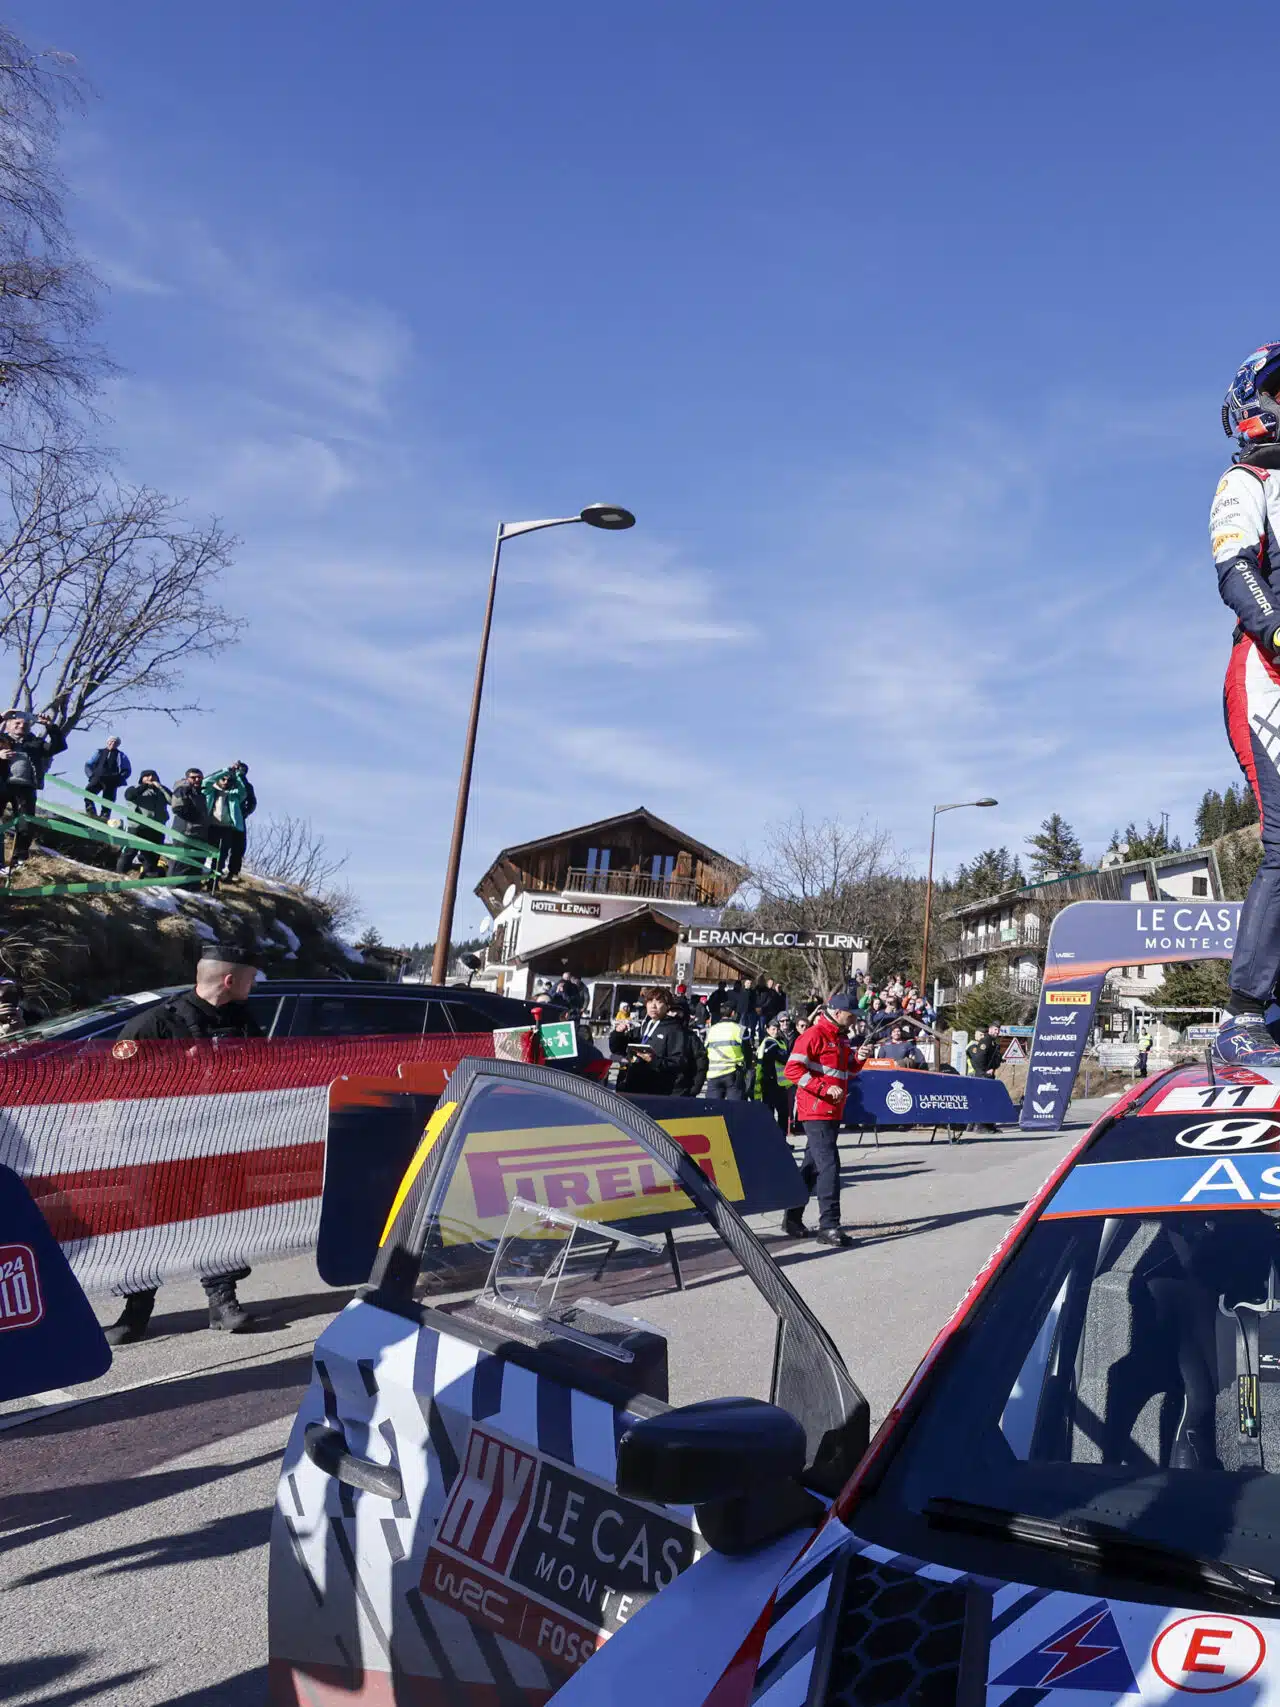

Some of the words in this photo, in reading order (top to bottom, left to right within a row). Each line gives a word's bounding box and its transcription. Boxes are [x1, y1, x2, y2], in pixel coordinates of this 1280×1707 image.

[1242, 571, 1274, 616] HYUNDAI
[532, 901, 559, 912] HOTEL
[1136, 909, 1166, 932] LE
[773, 933, 806, 947] COL
[1145, 938, 1210, 949] MONTE
[677, 963, 686, 985] HOT
[920, 1094, 929, 1102] LA
[930, 1094, 968, 1102] BOUTIQUE
[920, 1101, 969, 1110] OFFICIELLE
[1198, 1085, 1255, 1108] 11
[0, 1271, 32, 1318] LO
[536, 1480, 585, 1546] LE
[592, 1509, 701, 1592] CAS
[434, 1563, 509, 1624] WRC
[534, 1552, 633, 1624] MONTE
[537, 1618, 599, 1665] FOSS
[1181, 1627, 1233, 1674] E
